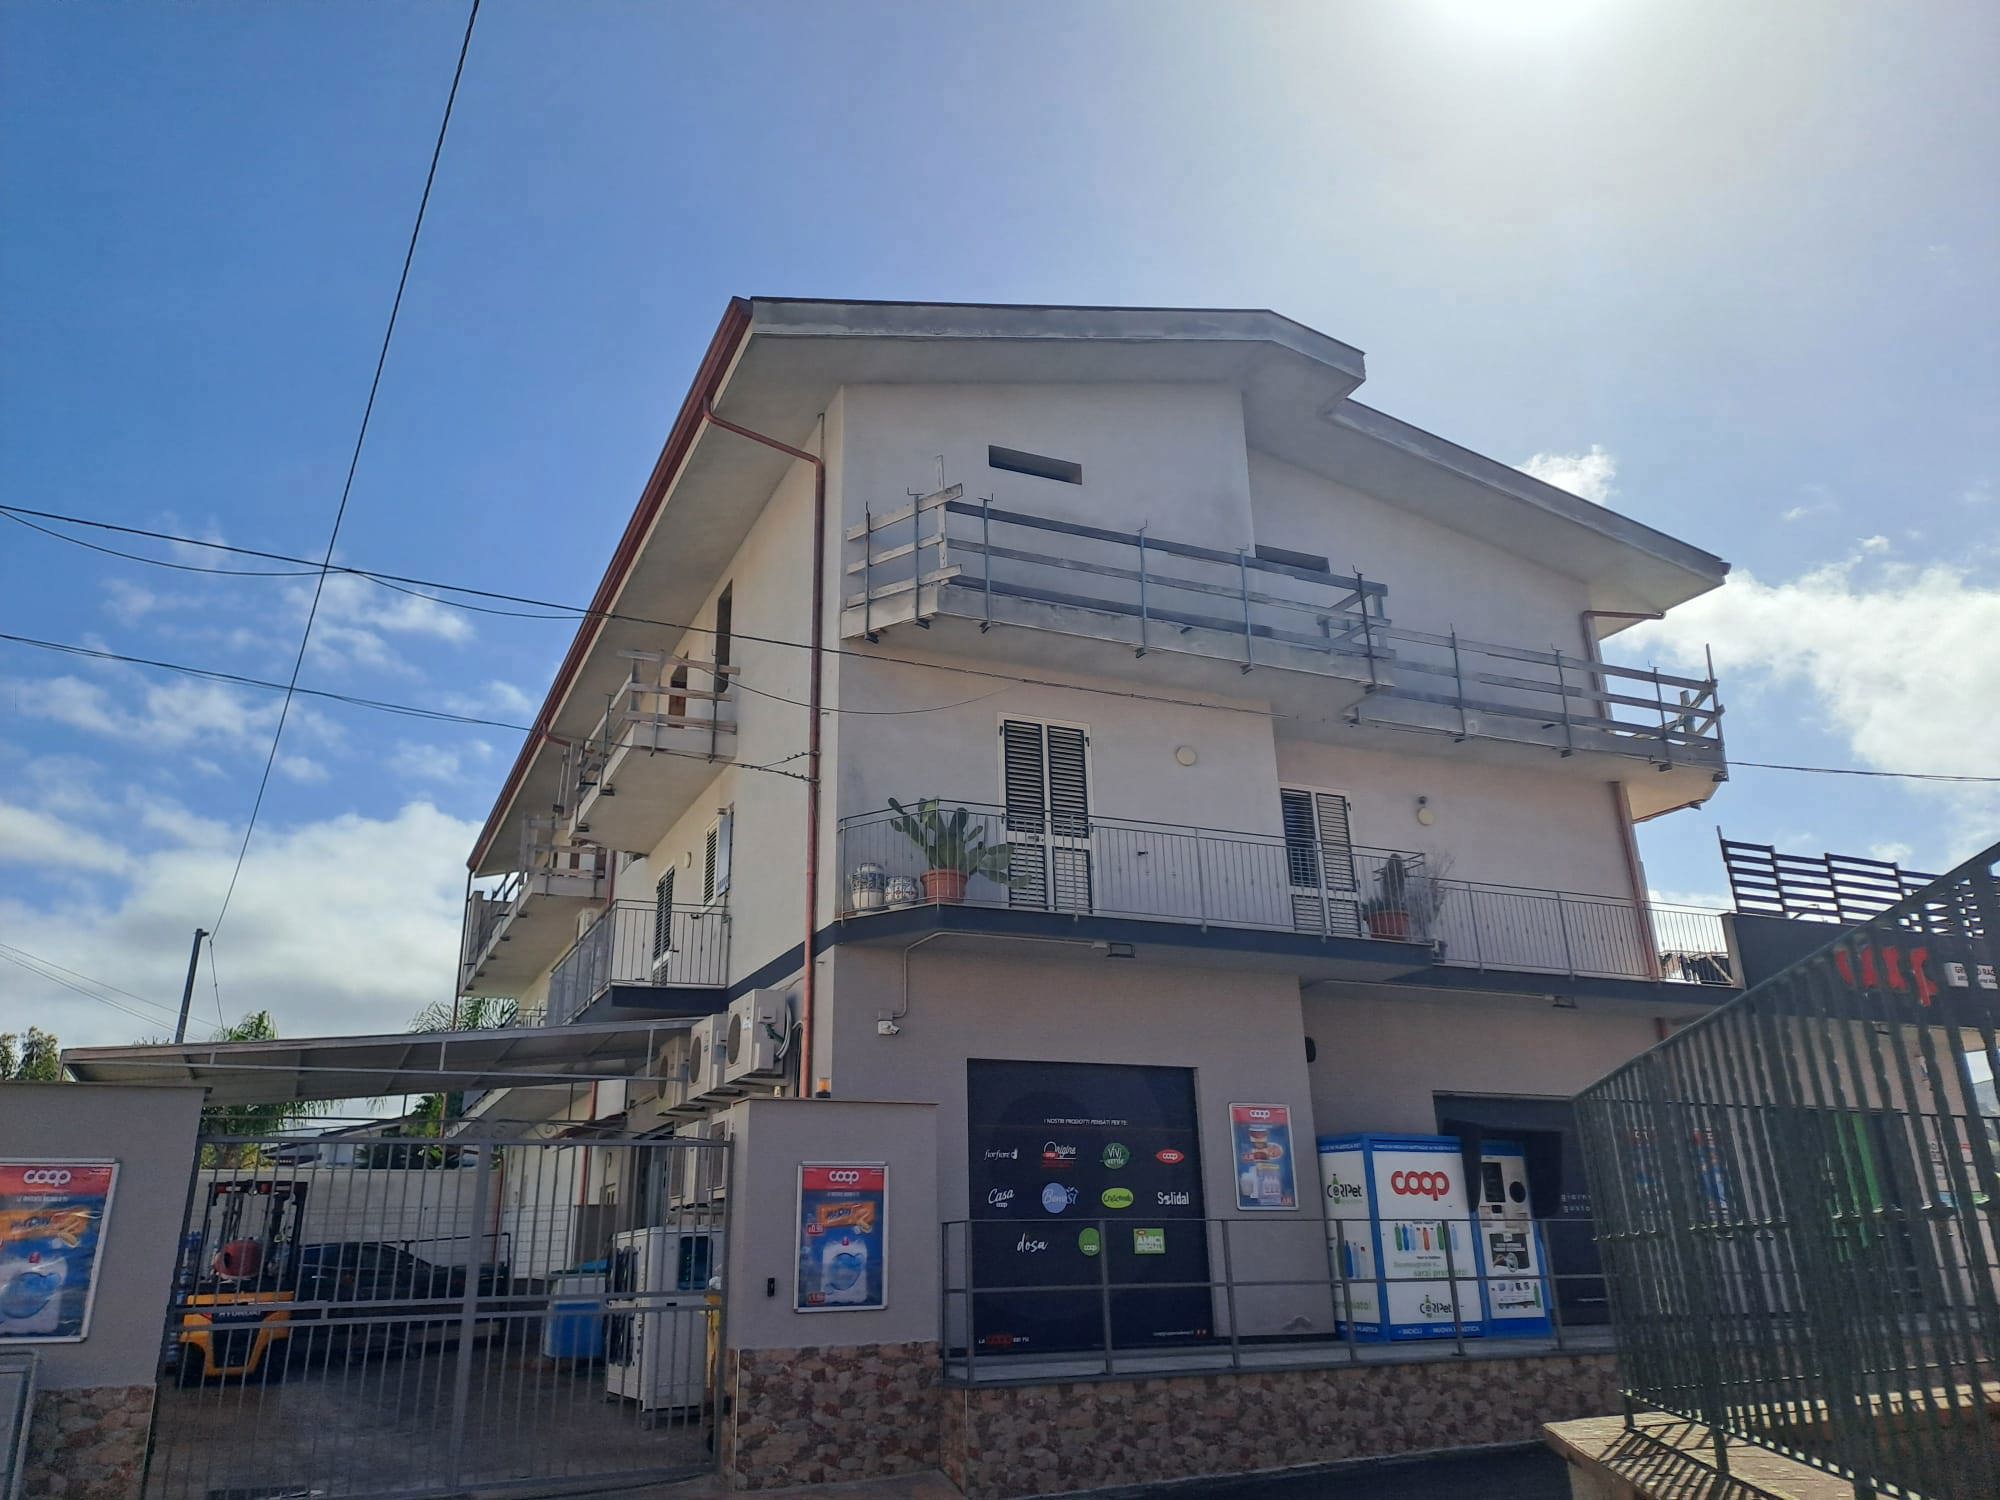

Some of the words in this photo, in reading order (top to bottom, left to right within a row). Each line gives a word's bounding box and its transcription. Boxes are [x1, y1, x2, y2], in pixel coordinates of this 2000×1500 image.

[1249, 1110, 1271, 1120] coop
[1043, 1141, 1077, 1158] Origine
[1162, 1152, 1178, 1160] coop
[24, 1169, 71, 1187] coop
[828, 1170, 860, 1185] coop
[1391, 1171, 1450, 1201] coop
[988, 1188, 1015, 1204] Casa
[1157, 1191, 1189, 1205] Solidal
